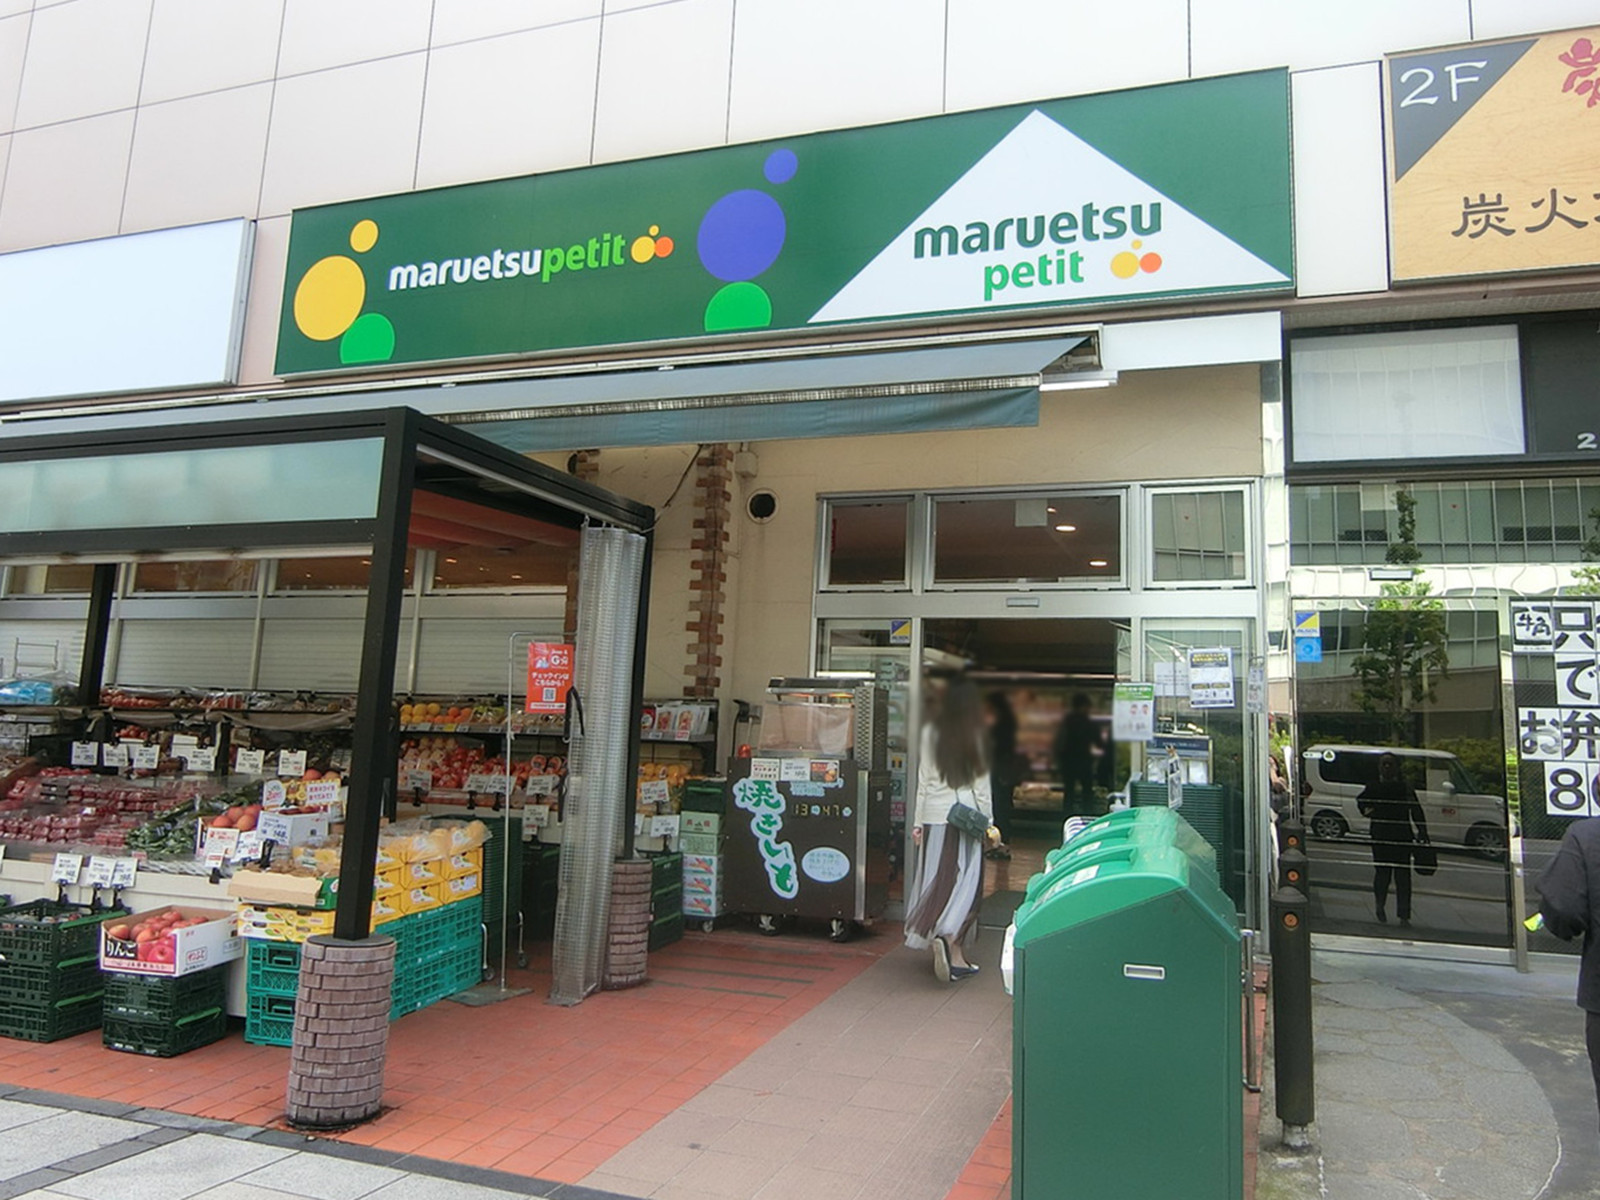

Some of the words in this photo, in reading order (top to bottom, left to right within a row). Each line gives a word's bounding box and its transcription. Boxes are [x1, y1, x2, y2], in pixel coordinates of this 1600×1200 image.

[1400, 61, 1488, 108] 2F
[914, 202, 1162, 259] maruetsu
[1451, 187, 1600, 240] 炭火
[984, 249, 1084, 301] petit
[1577, 433, 1597, 449] 2
[1554, 606, 1600, 650] 只
[1556, 658, 1600, 700] で
[1520, 709, 1600, 759] お弁
[1549, 768, 1600, 811] 8
